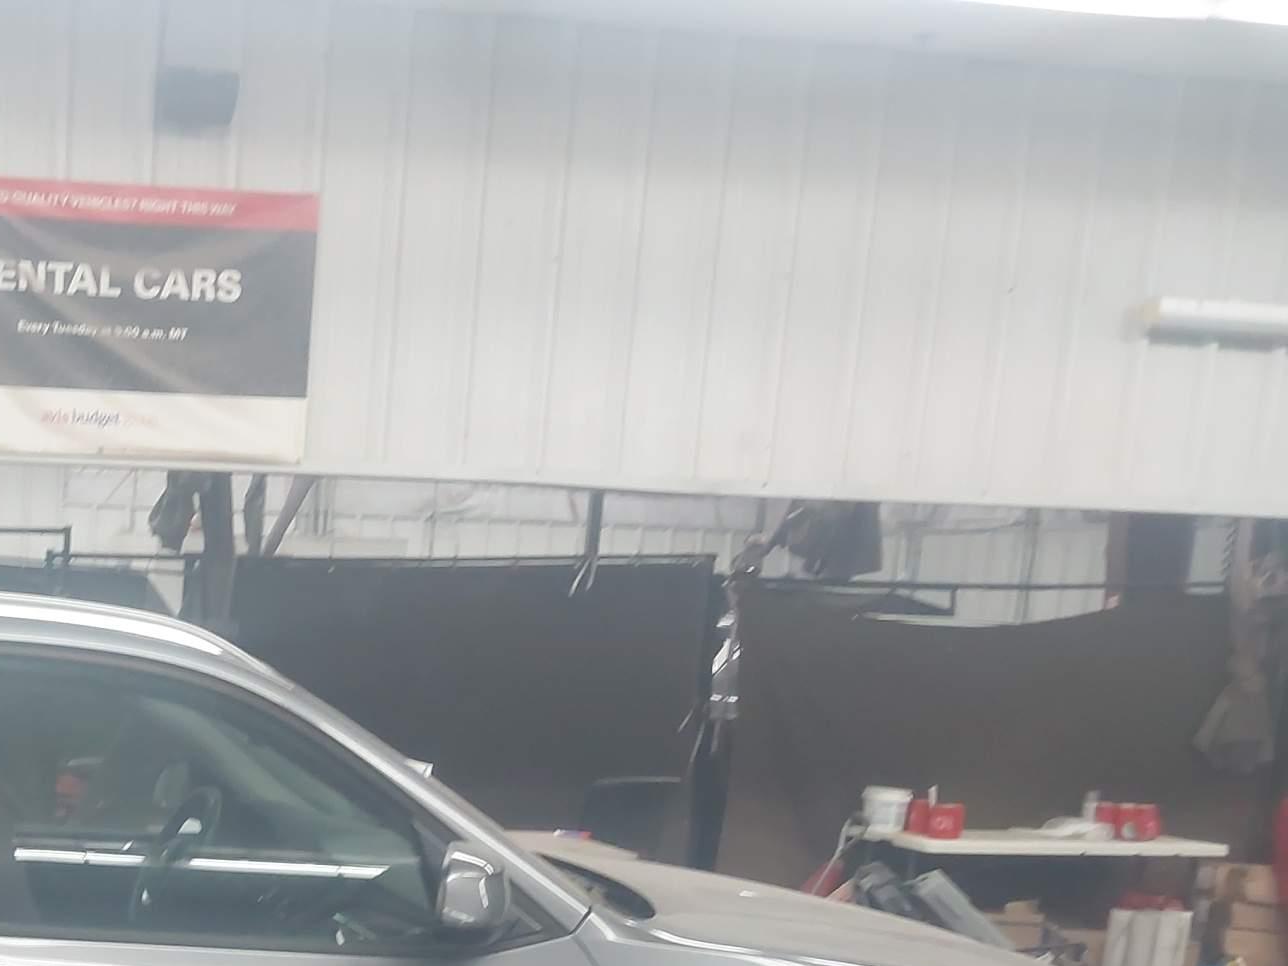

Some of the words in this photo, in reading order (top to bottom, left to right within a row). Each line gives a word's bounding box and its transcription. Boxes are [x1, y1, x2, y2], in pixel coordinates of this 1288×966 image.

[11, 189, 70, 207] QUALITY
[140, 197, 178, 214] RIGHT
[180, 199, 209, 215] THIS
[133, 266, 242, 303] CARS
[17, 319, 50, 336] Every
